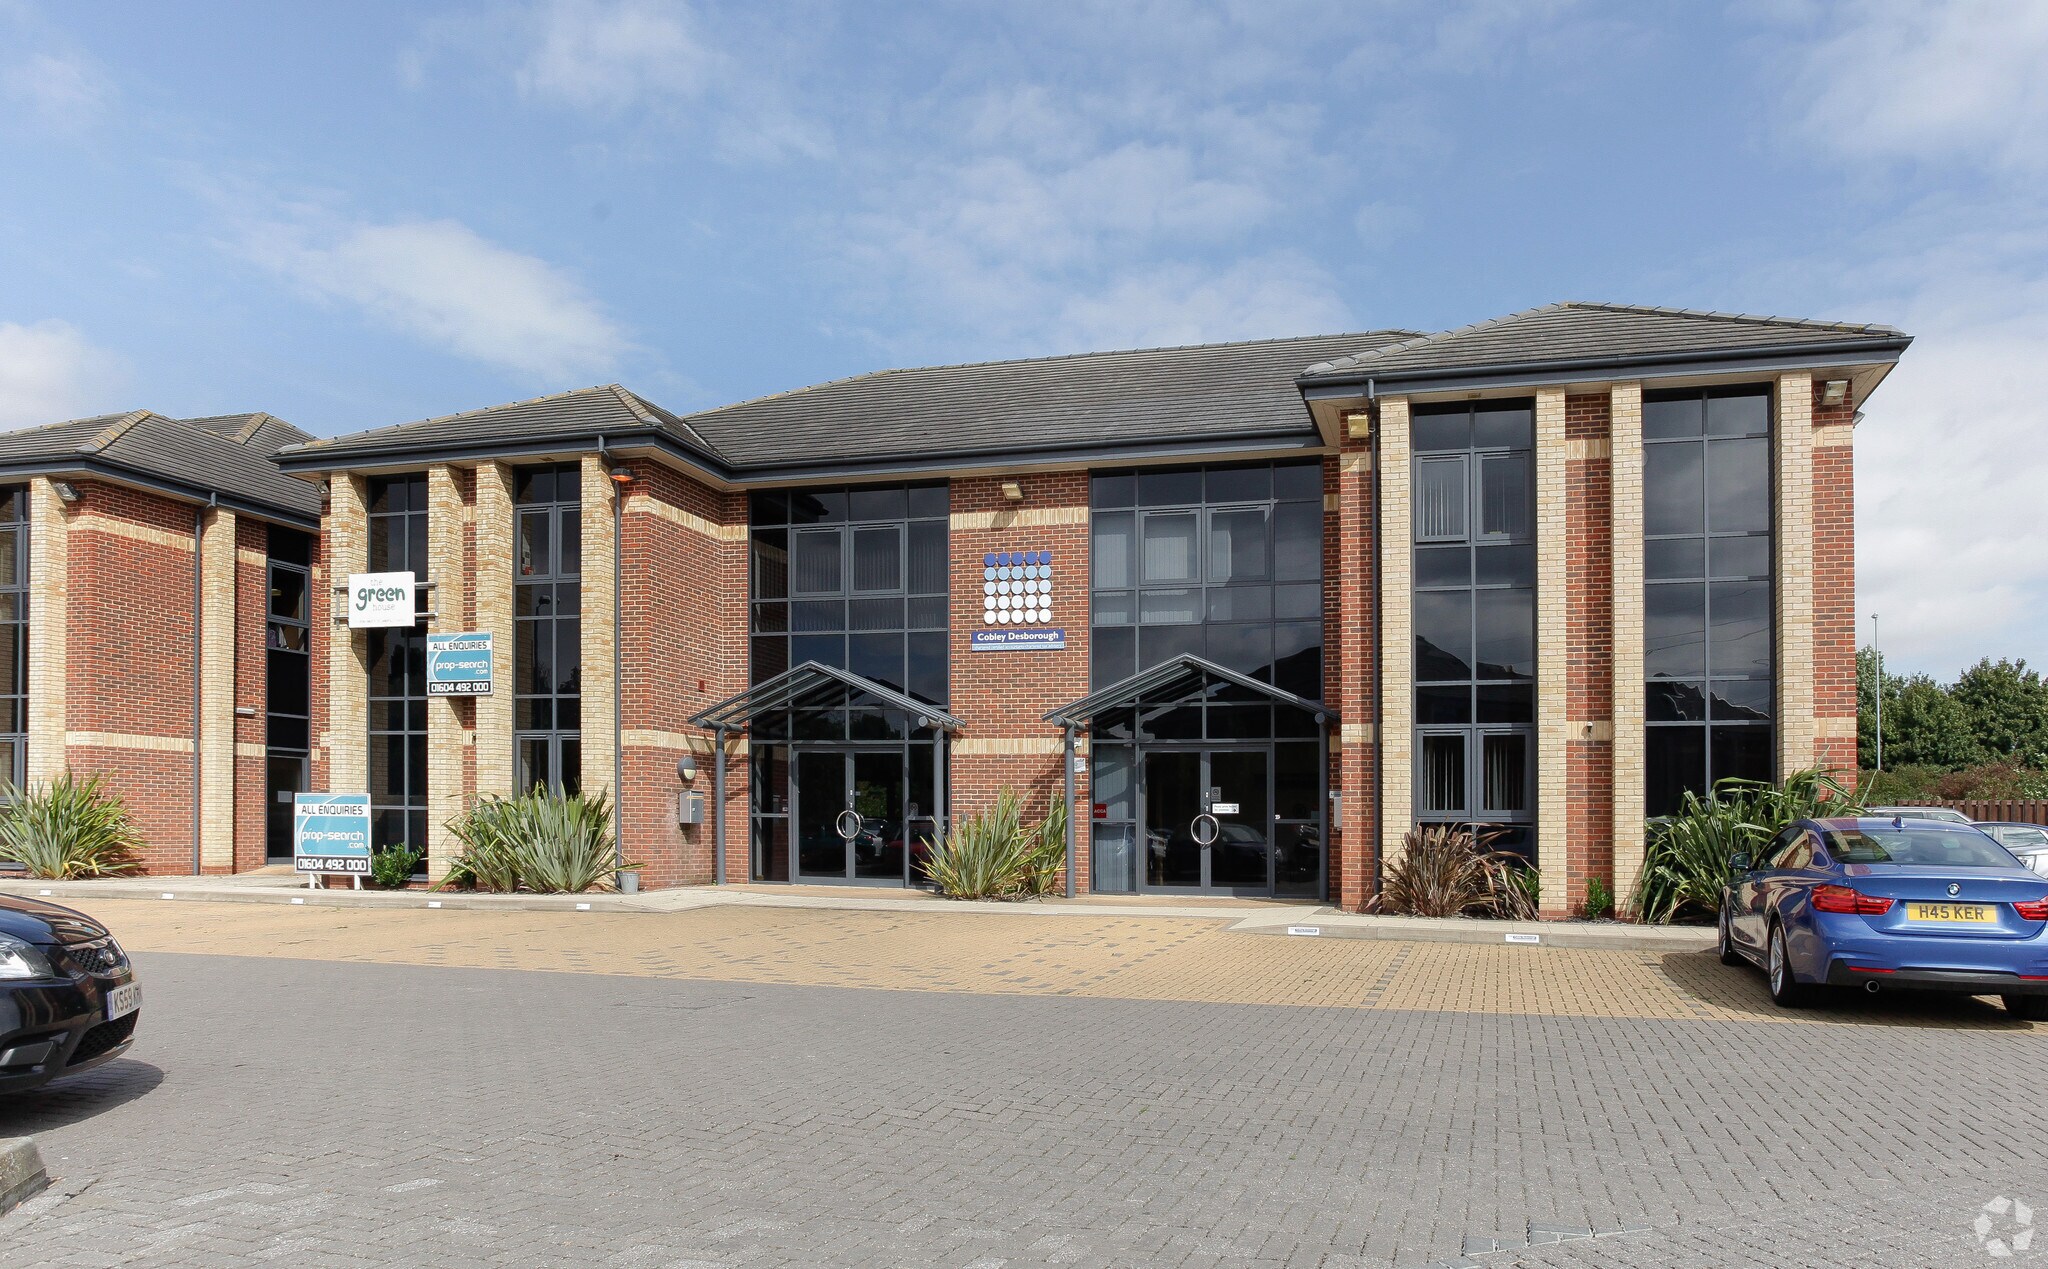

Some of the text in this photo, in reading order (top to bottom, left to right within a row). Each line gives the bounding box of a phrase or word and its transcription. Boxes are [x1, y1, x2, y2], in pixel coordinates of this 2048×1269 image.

[370, 578, 383, 586] the
[355, 587, 405, 611] green
[372, 604, 396, 612] house
[977, 631, 1059, 642] Cobley Desborough
[433, 641, 488, 650] ALL ENQUIRIES
[436, 660, 488, 671] prop-search
[431, 682, 488, 692] 01604 492 000
[302, 805, 363, 815] ALL ENQUIRIES
[302, 830, 364, 842] prop-search
[298, 858, 366, 871] 01604 492 000
[1919, 905, 1985, 920] H45 KER
[114, 987, 133, 1013] KS59
